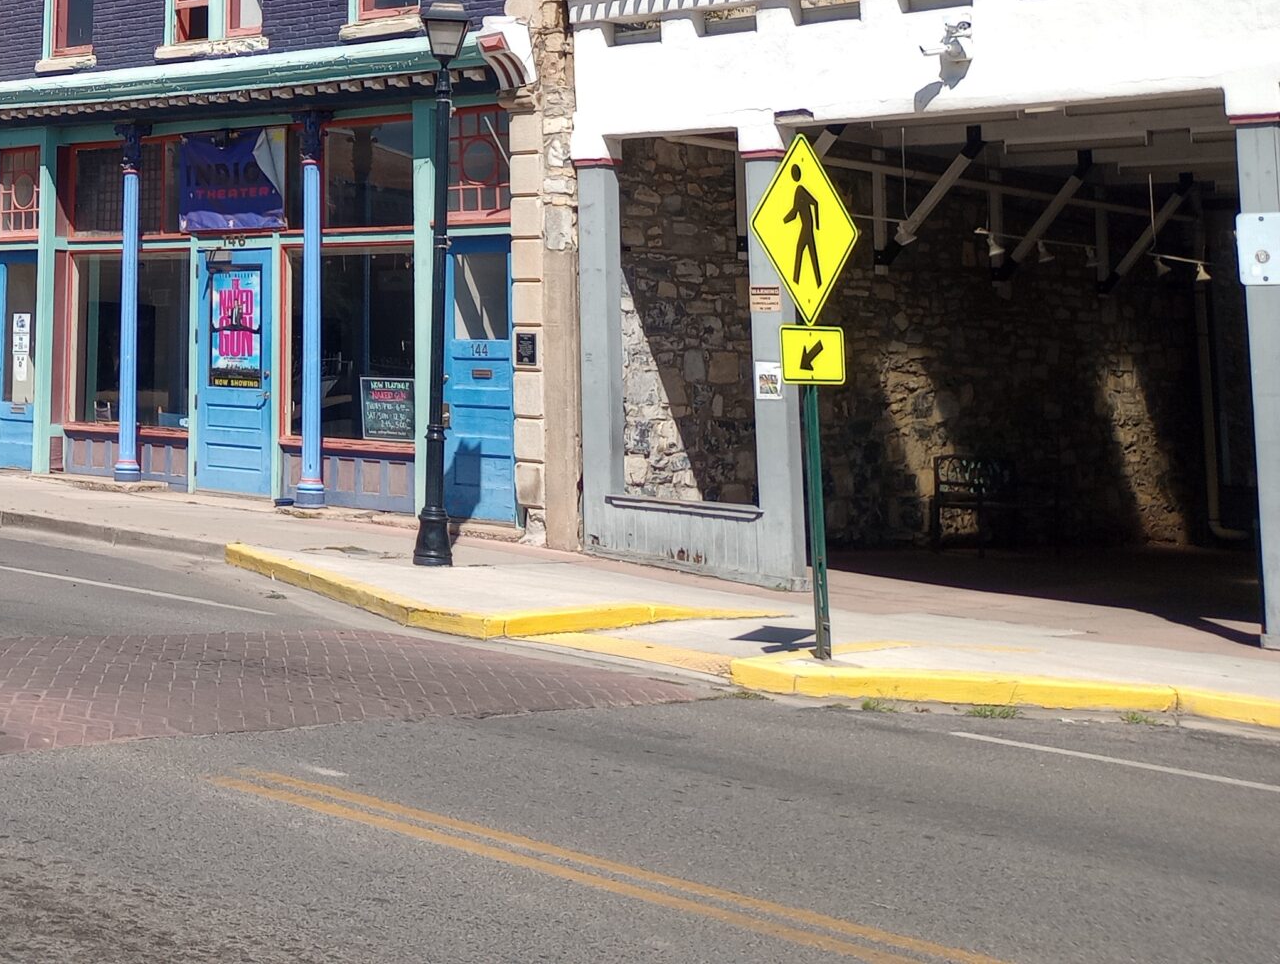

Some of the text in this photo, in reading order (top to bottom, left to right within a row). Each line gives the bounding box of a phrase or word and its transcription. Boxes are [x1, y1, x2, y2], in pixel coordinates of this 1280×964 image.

[196, 187, 270, 199] THEATER
[219, 289, 253, 316] NAKED
[219, 317, 253, 357] GUN
[471, 343, 488, 356] 144
[231, 379, 259, 387] SHOWING
